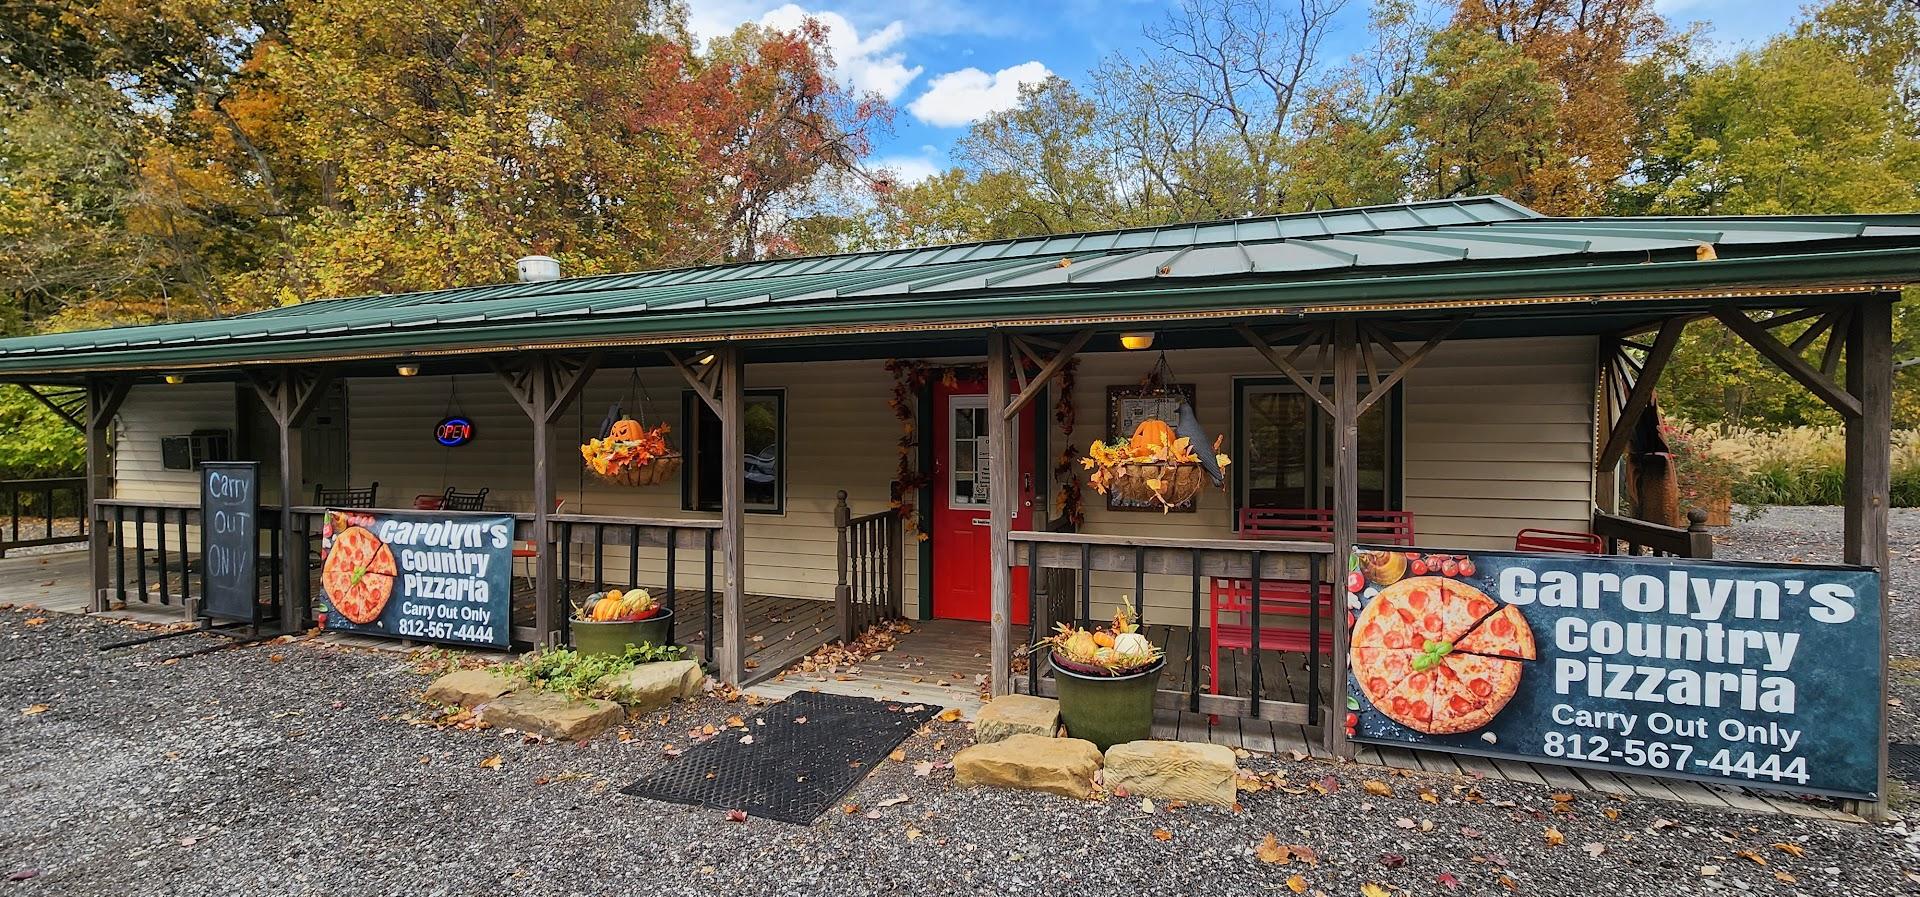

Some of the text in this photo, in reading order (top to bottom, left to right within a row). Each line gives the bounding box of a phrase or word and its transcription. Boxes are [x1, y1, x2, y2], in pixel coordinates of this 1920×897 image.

[437, 424, 470, 439] OPEN
[209, 472, 249, 506] Carry
[214, 510, 250, 536] OUT
[379, 519, 508, 550] Carolyn's
[401, 549, 490, 578] Country
[404, 573, 489, 603] Pizzaria
[1500, 567, 1855, 624] Carolyn's
[402, 601, 491, 625] Carry Out Only
[398, 619, 494, 644] 812-567-4444
[1555, 616, 1800, 672] Country
[1555, 656, 1796, 714] Pizzaria
[1551, 703, 1801, 753] Carry Out Only
[1543, 731, 1810, 785] 812-567-4444
